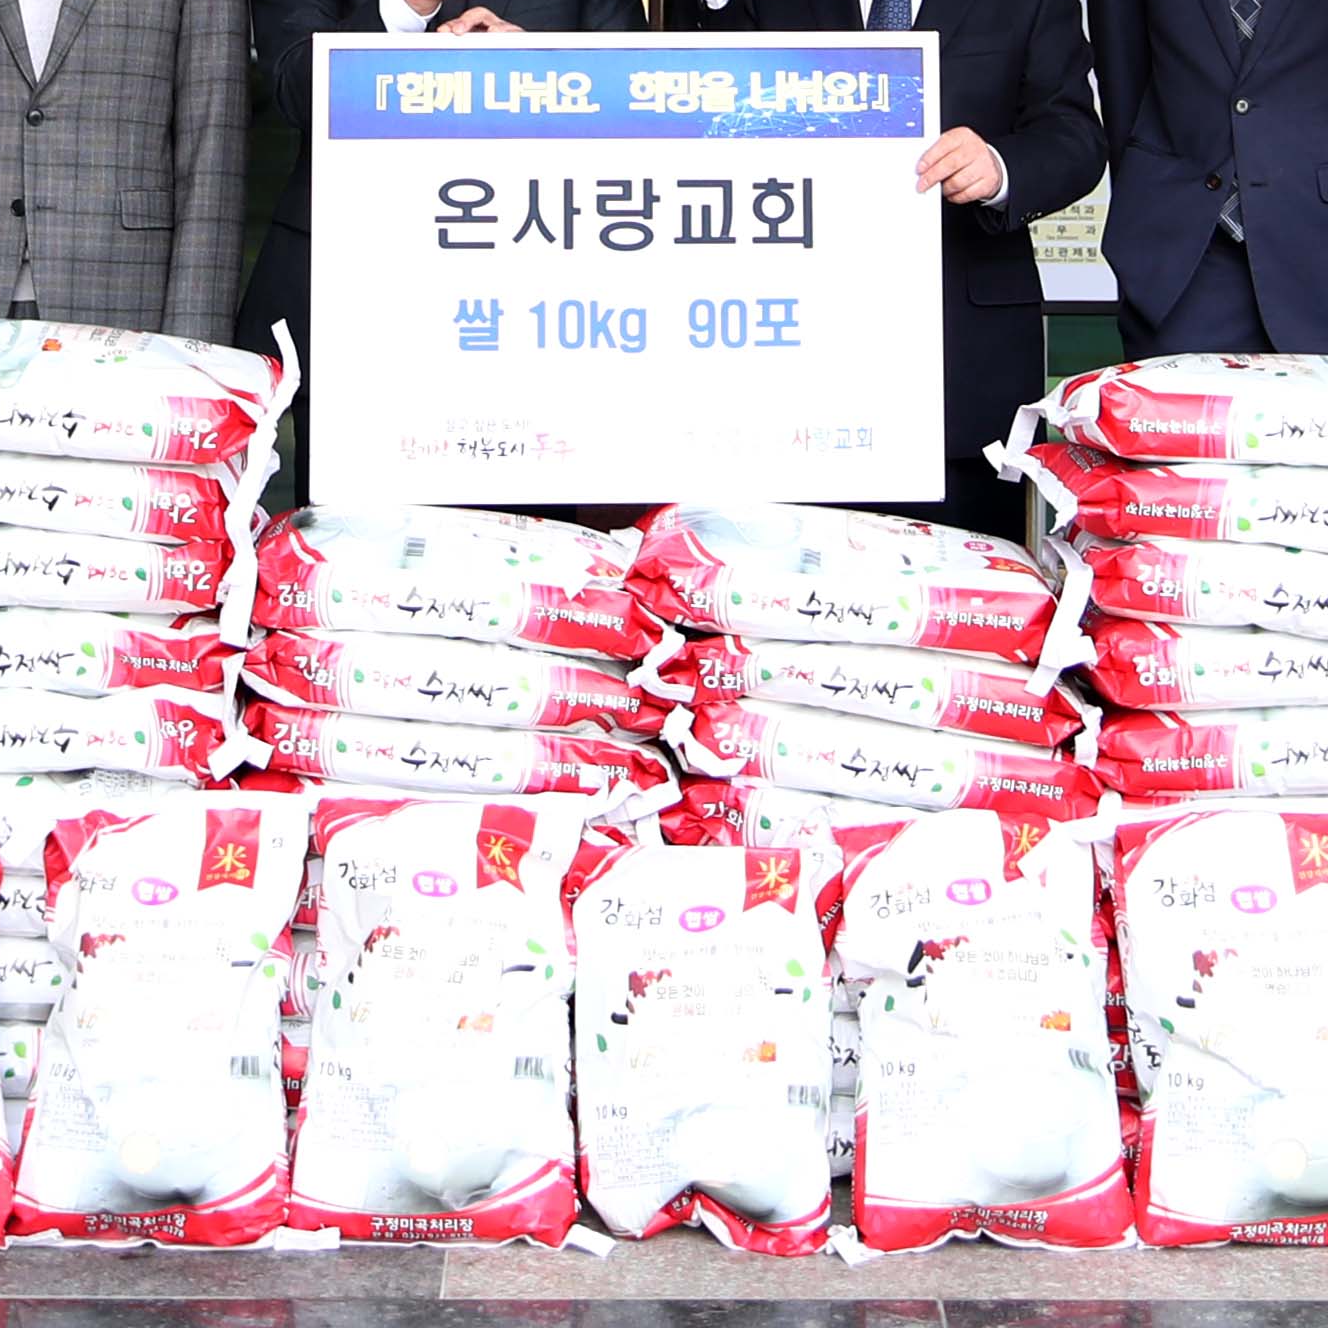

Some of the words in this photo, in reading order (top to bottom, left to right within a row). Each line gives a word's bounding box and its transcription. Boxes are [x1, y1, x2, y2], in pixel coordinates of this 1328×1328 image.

[435, 177, 814, 251] 온사랑교회
[453, 297, 504, 352] 쌀
[529, 299, 648, 354] 10kg
[688, 298, 802, 350] 90포
[1135, 564, 1183, 601] 강화
[294, 655, 337, 690] 강화
[698, 659, 744, 692] 강화
[1132, 653, 1178, 689] 강화
[274, 723, 319, 760] 강화
[212, 844, 247, 870] 米
[483, 835, 513, 865] 米
[339, 862, 398, 891] 강화섬
[757, 857, 790, 888] 米
[871, 886, 932, 920] 강화섬
[1153, 877, 1217, 908] 강화섬
[600, 897, 664, 931] 강화섬
[880, 1062, 893, 1078] 10
[898, 1060, 916, 1076] kg
[1168, 1074, 1182, 1088] 10
[1187, 1073, 1205, 1090] kg
[595, 1106, 609, 1120] 10
[612, 1105, 629, 1123] kg
[369, 1216, 475, 1233] 구정미곡처리장
[1229, 1221, 1328, 1240] 구정미곡처리장
